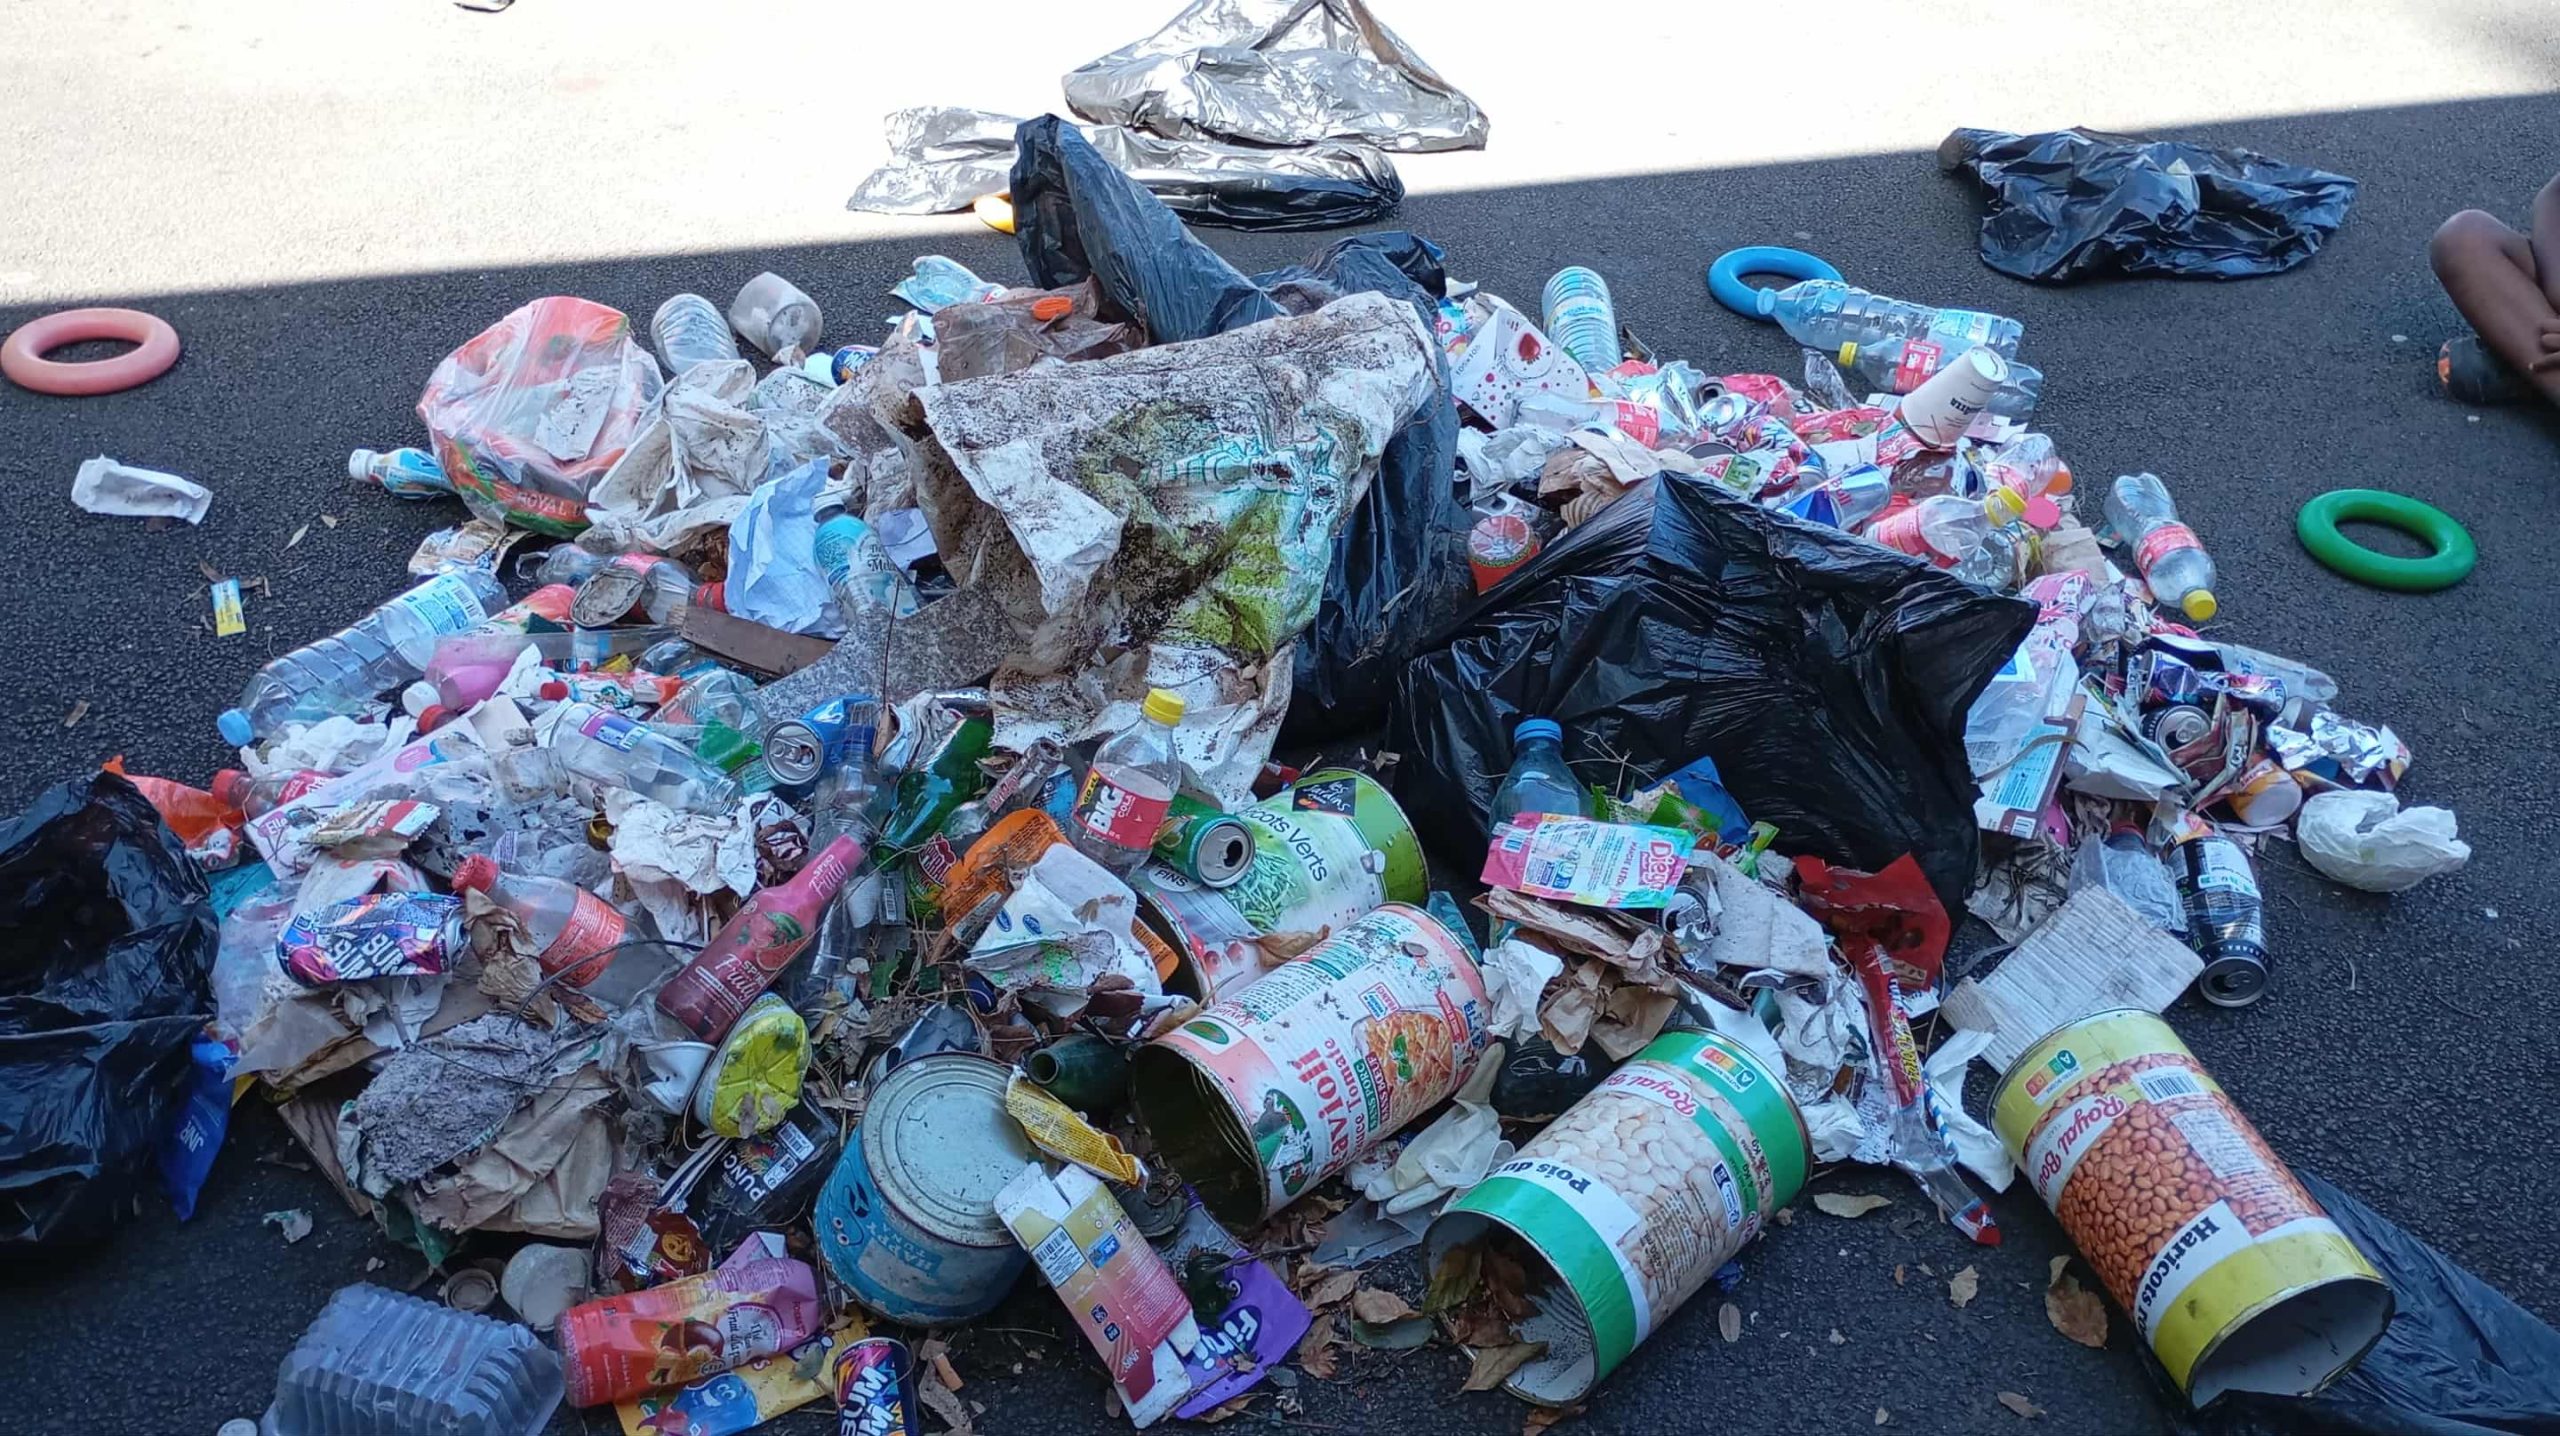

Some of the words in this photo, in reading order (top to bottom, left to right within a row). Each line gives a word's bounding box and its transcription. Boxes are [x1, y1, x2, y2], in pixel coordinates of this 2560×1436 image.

[519, 492, 567, 516] ROYAL
[1089, 784, 1125, 834] BIG
[1116, 794, 1137, 819] COLA
[1288, 827, 1329, 883] Verts
[1154, 869, 1189, 887] FINS
[714, 952, 756, 1000] Fruity
[1324, 1038, 1363, 1113] Tomate
[1356, 1061, 1373, 1093] PORC
[1630, 1075, 1697, 1116] Royal
[2058, 1095, 2126, 1155] Royal
[1502, 1158, 1534, 1174] du
[1750, 1138, 1763, 1154] Kg
[722, 1149, 767, 1202] PUNC
[1536, 1162, 1592, 1194] Pois
[1740, 1163, 1753, 1179] Kg
[2141, 1215, 2221, 1308] Haricots
[1191, 1308, 1259, 1370] Fini
